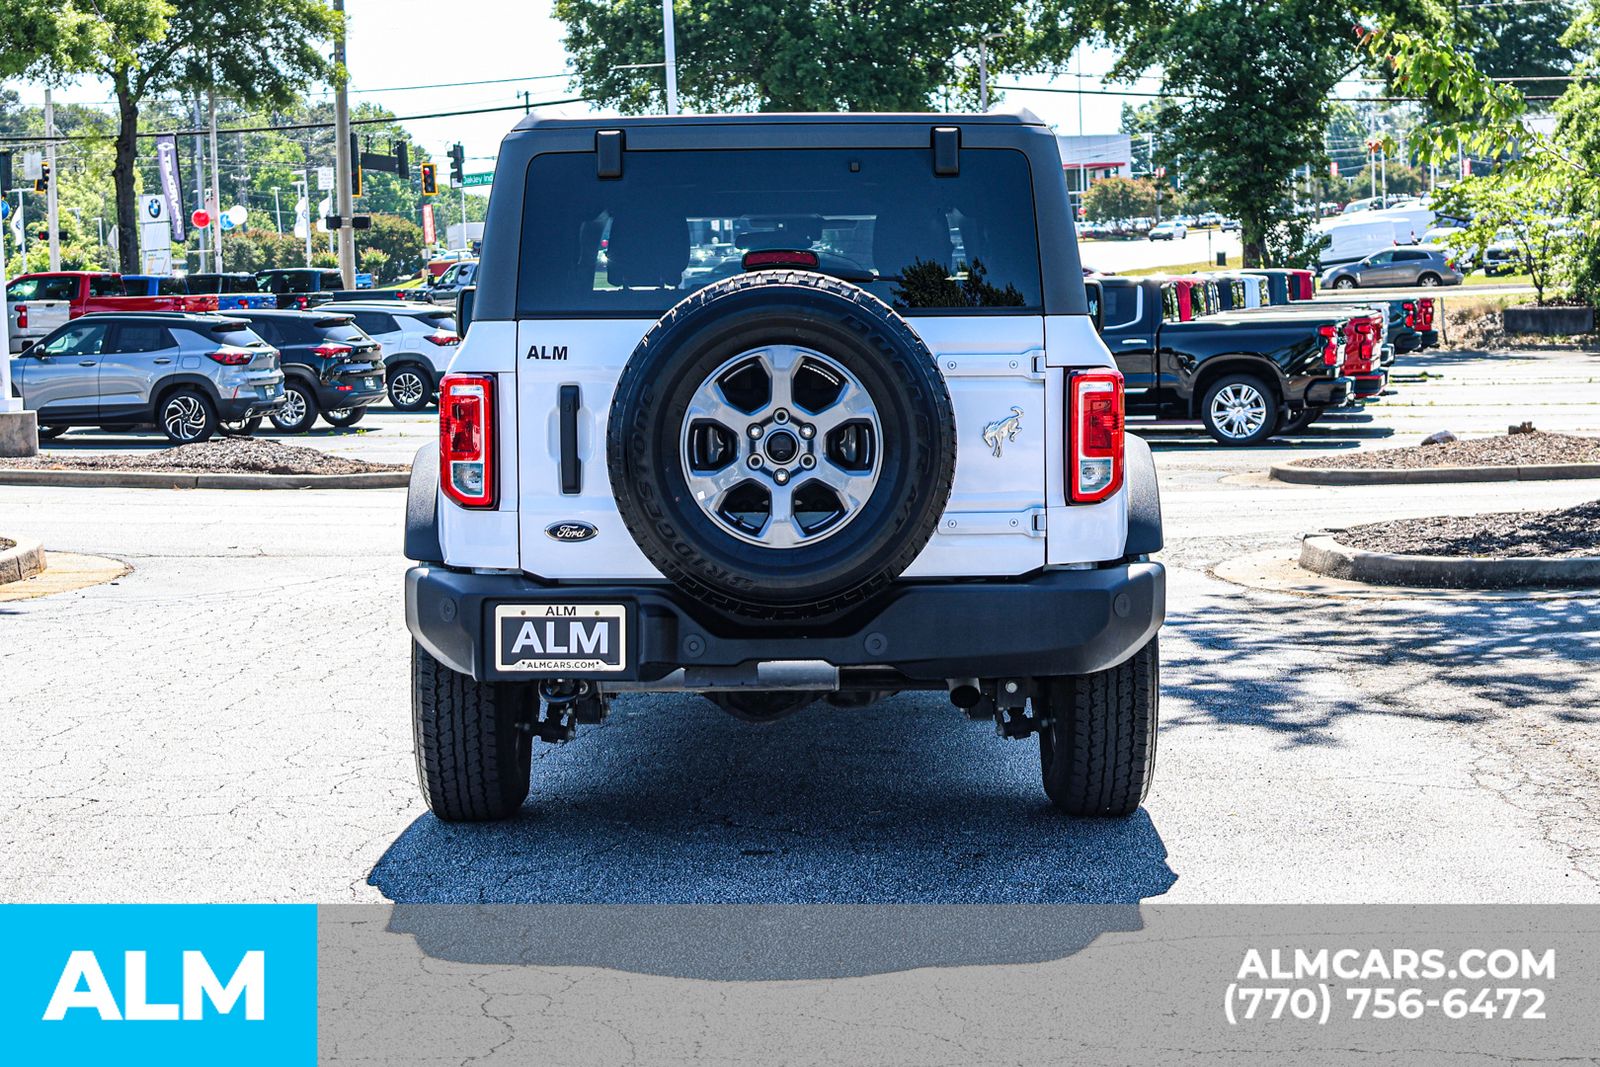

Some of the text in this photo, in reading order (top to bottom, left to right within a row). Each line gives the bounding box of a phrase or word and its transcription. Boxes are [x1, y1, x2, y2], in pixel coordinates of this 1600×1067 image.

[527, 346, 568, 360] ALM
[631, 383, 756, 590] BRIDGESTONE
[556, 525, 586, 538] Ford
[545, 606, 576, 616] ALM
[511, 621, 609, 654] ALM
[527, 661, 595, 669] ALMCARS.COM
